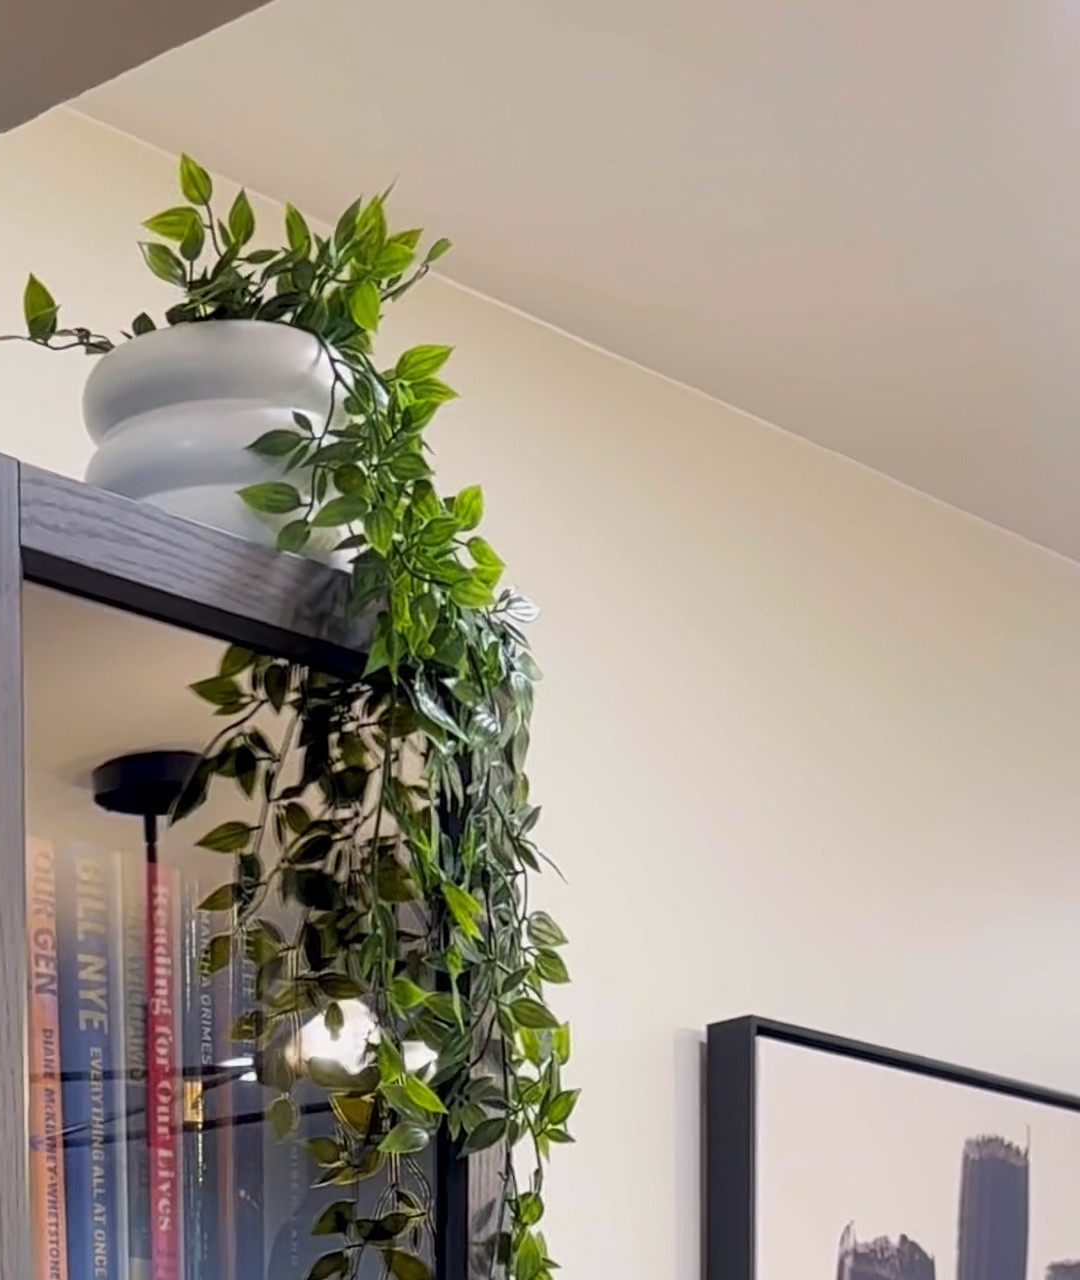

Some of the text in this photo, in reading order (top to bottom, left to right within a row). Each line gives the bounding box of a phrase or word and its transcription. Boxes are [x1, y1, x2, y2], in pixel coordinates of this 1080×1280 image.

[34, 927, 57, 997] GEN
[75, 857, 109, 1035] BILL NYE
[200, 994, 213, 1066] GRIMES
[155, 1080, 174, 1138] Our
[89, 1046, 109, 1280] EVERYTHING ALL AT ONCE
[156, 1149, 175, 1232] Lives
